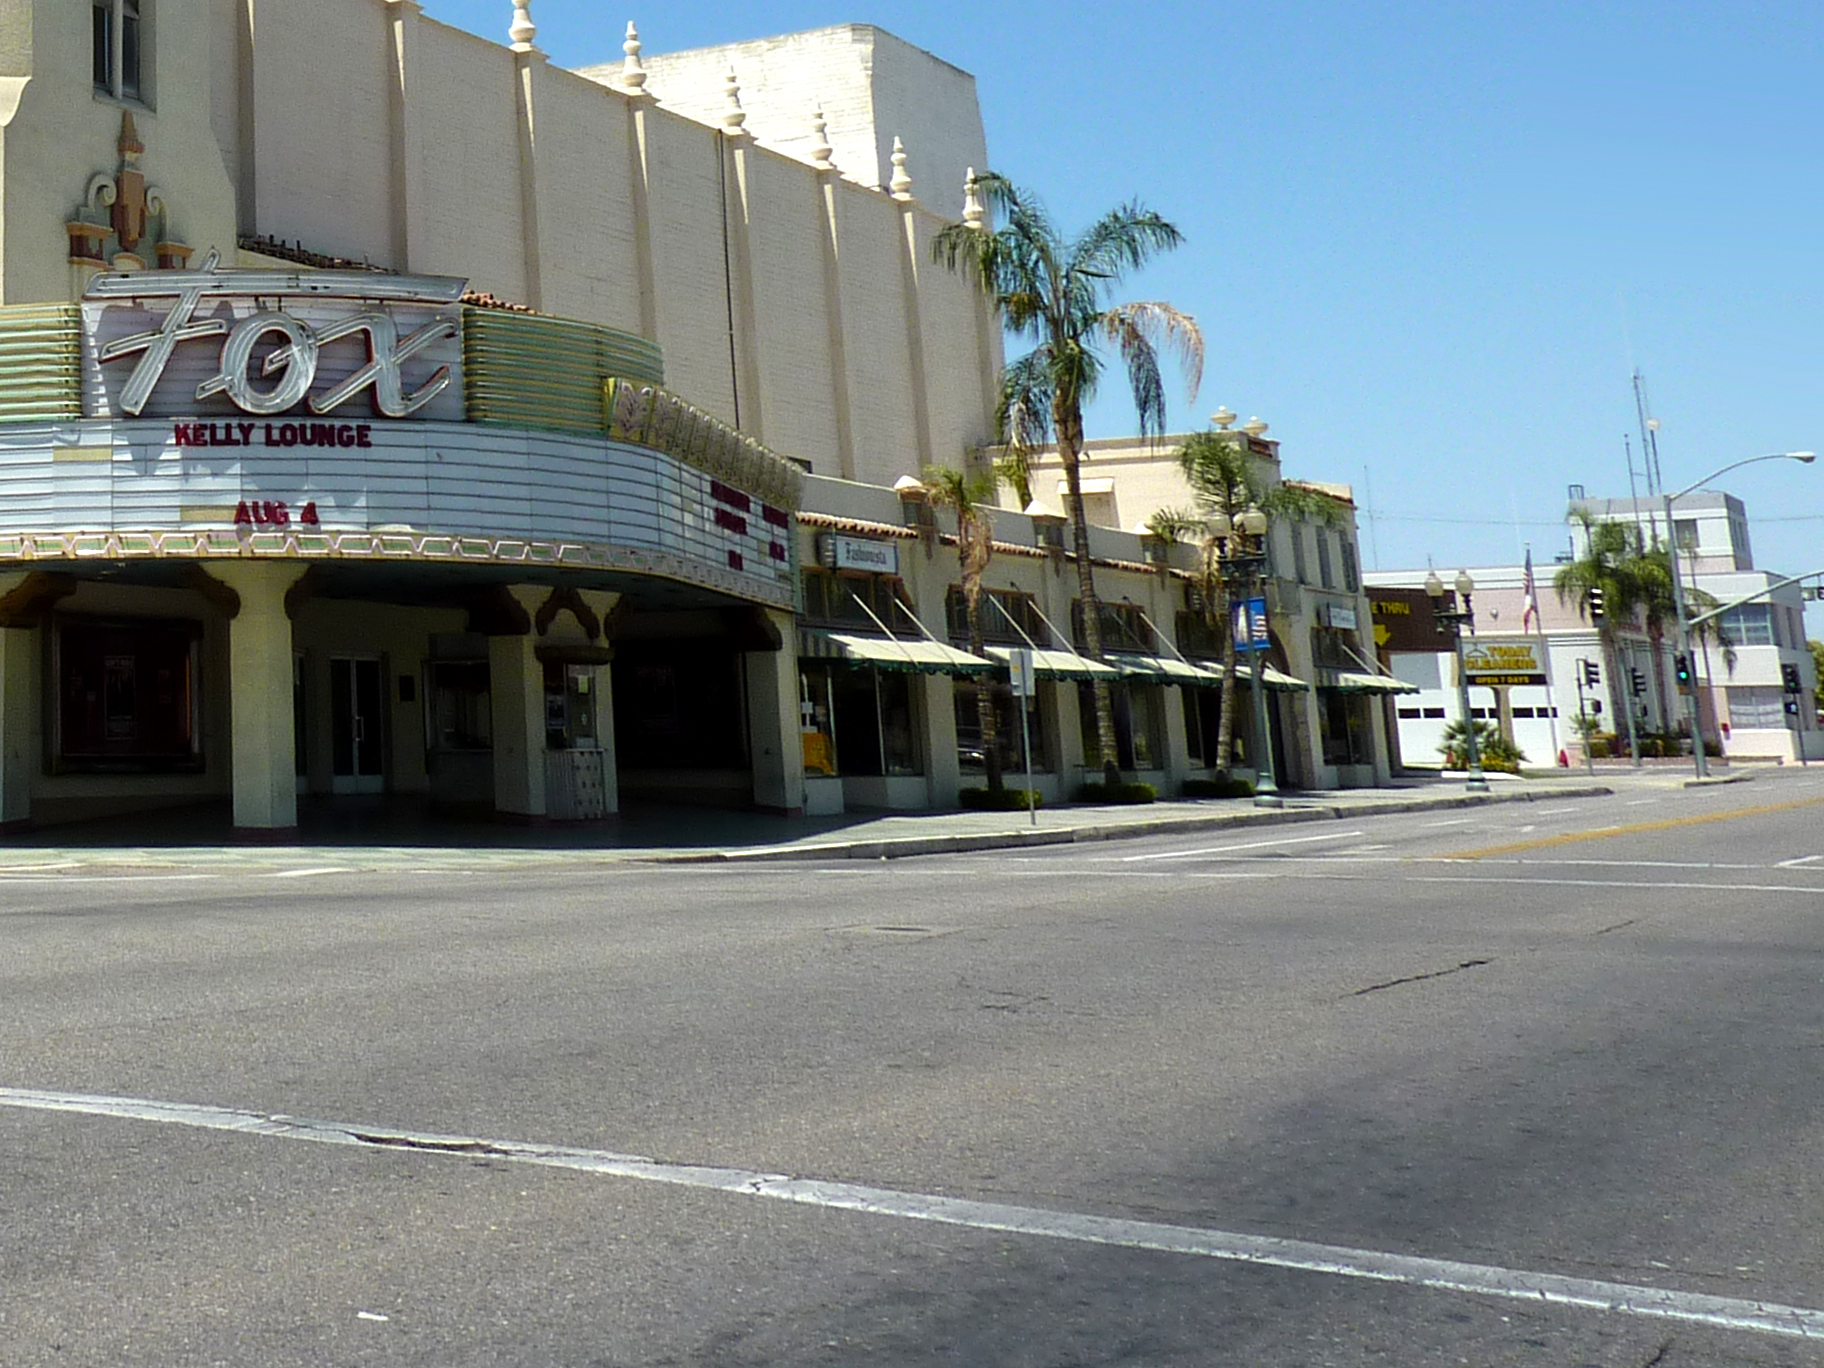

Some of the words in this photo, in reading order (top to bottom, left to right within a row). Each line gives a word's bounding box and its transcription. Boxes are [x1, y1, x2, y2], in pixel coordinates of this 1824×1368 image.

[174, 423, 255, 447] KELLY
[265, 423, 373, 448] LOUNGE
[234, 500, 290, 526] AUG
[301, 501, 319, 526] 4
[1463, 657, 1538, 671] CLEANERS
[1475, 676, 1499, 684] OPEN
[1507, 676, 1530, 684] DAYS
